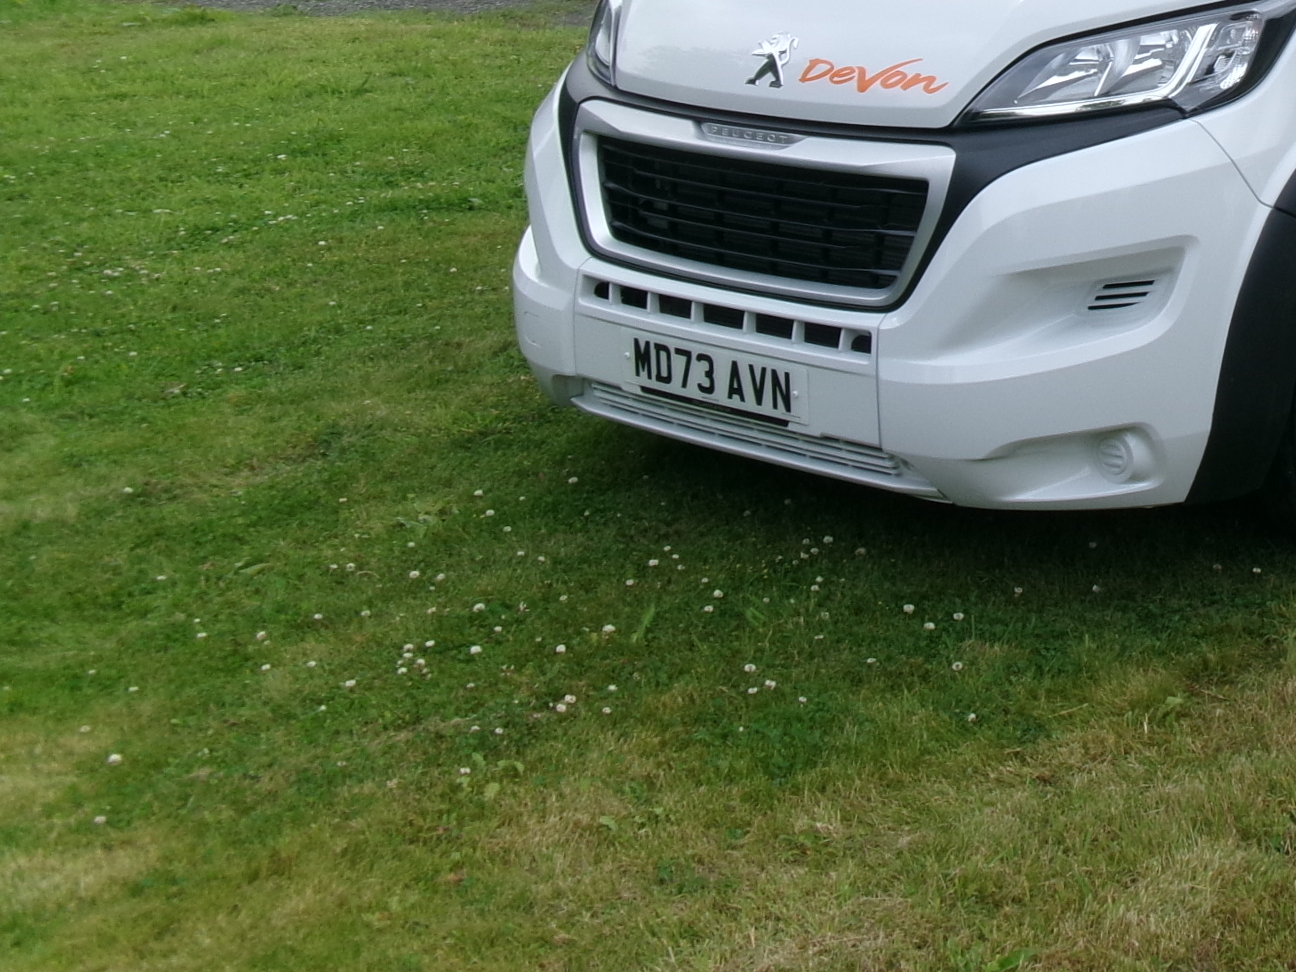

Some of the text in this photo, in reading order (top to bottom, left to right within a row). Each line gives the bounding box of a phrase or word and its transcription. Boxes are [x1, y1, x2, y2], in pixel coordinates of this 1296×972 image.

[711, 125, 788, 144] PEUGEOT
[633, 337, 792, 413] MD73 AVN
